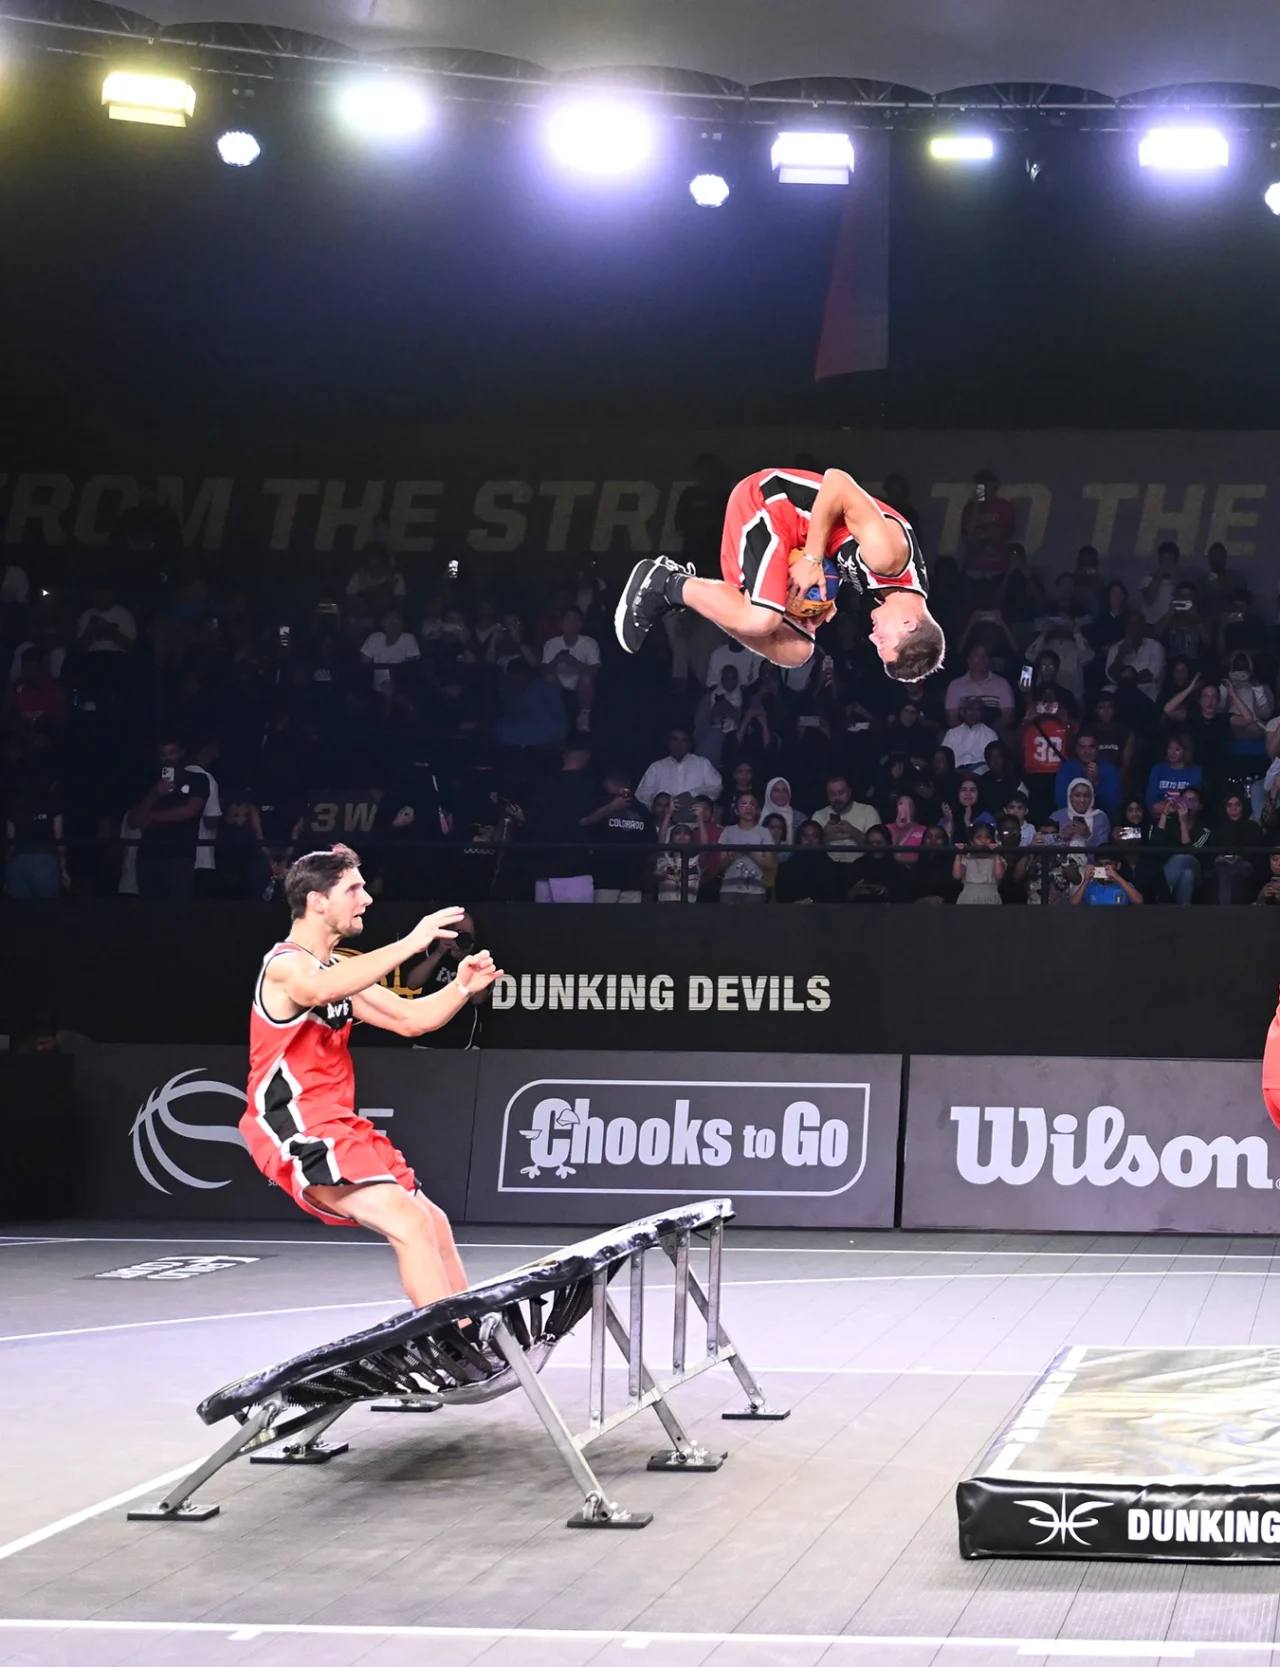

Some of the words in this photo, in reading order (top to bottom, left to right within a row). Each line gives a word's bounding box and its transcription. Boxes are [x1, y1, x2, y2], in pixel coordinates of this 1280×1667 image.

[0, 472, 234, 550] ROM
[261, 480, 443, 552] THE
[1083, 483, 1267, 558] THE
[491, 974, 675, 1011] DUNKING
[688, 975, 832, 1012] DEVILS
[529, 1097, 733, 1167] Chooks
[743, 1124, 776, 1159] to
[781, 1101, 849, 1167] Go
[950, 1105, 1273, 1189] Wilson
